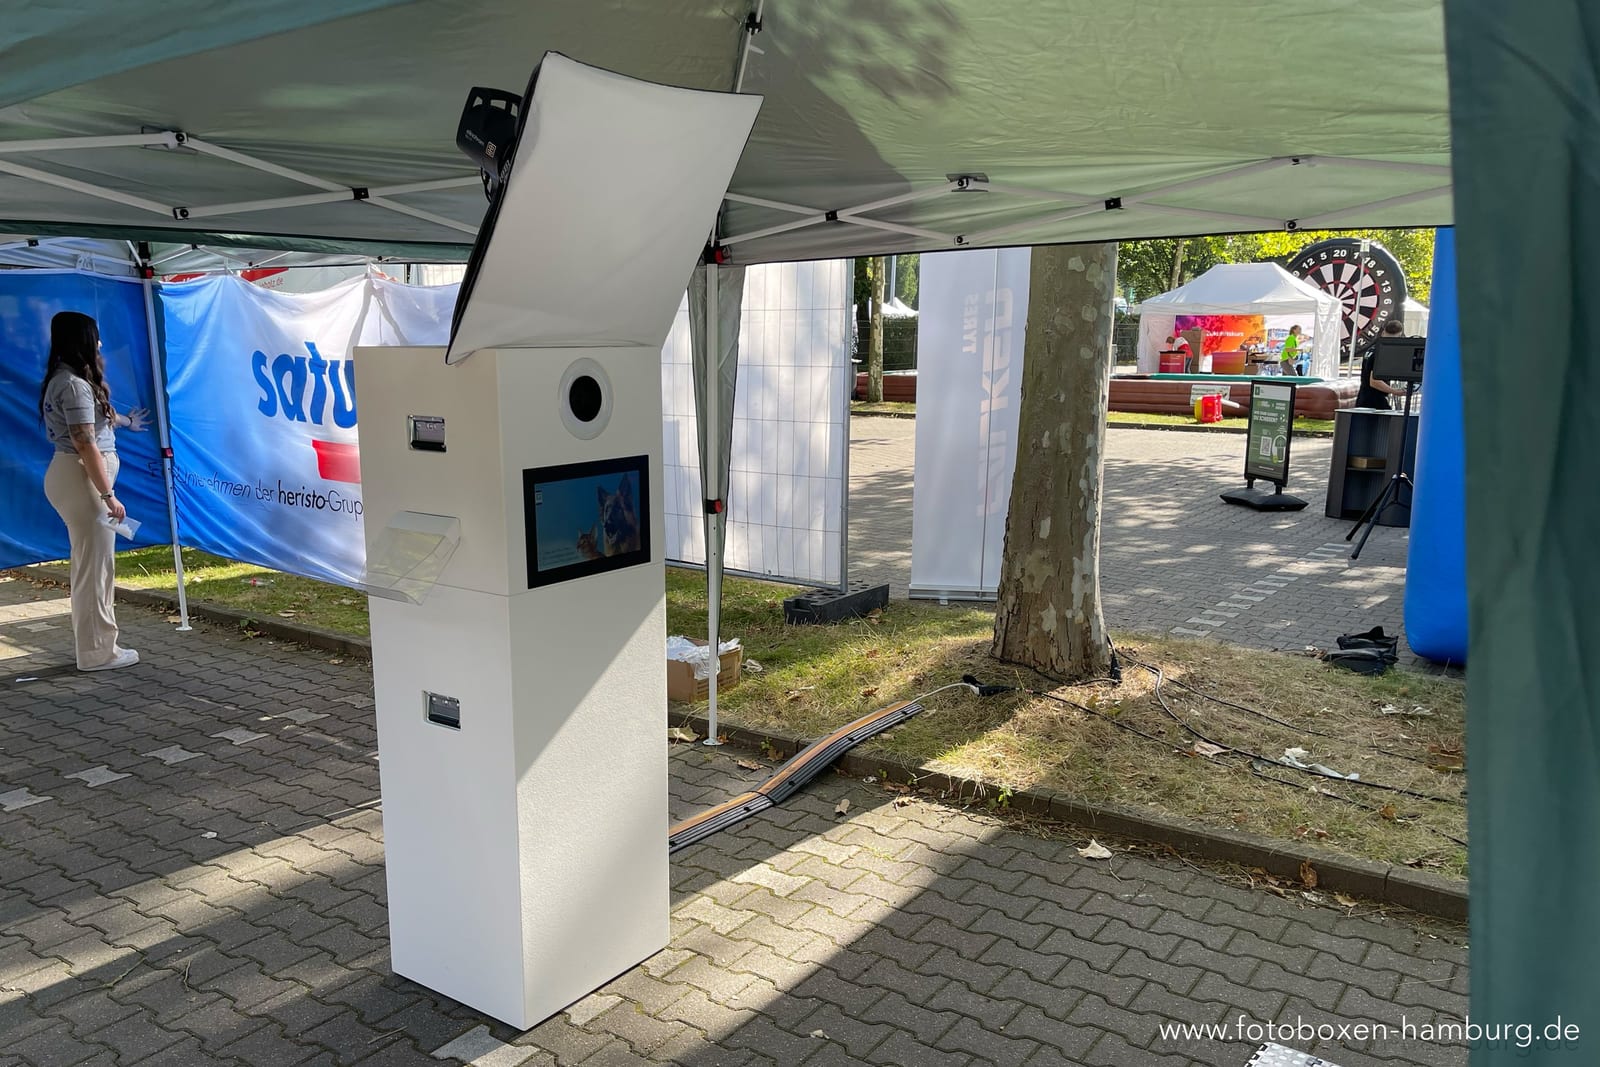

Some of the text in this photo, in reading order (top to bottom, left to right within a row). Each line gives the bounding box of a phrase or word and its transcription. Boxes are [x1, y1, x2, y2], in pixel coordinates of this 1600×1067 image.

[1320, 252, 1328, 260] 5
[1333, 249, 1347, 257] 20
[1302, 257, 1316, 269] 12
[1364, 257, 1376, 268] 18
[1375, 269, 1385, 277] 4
[1381, 280, 1392, 293] 13
[1378, 310, 1389, 322] 10
[1367, 325, 1380, 338] 15
[1357, 337, 1367, 347] 2
[255, 477, 274, 502] der
